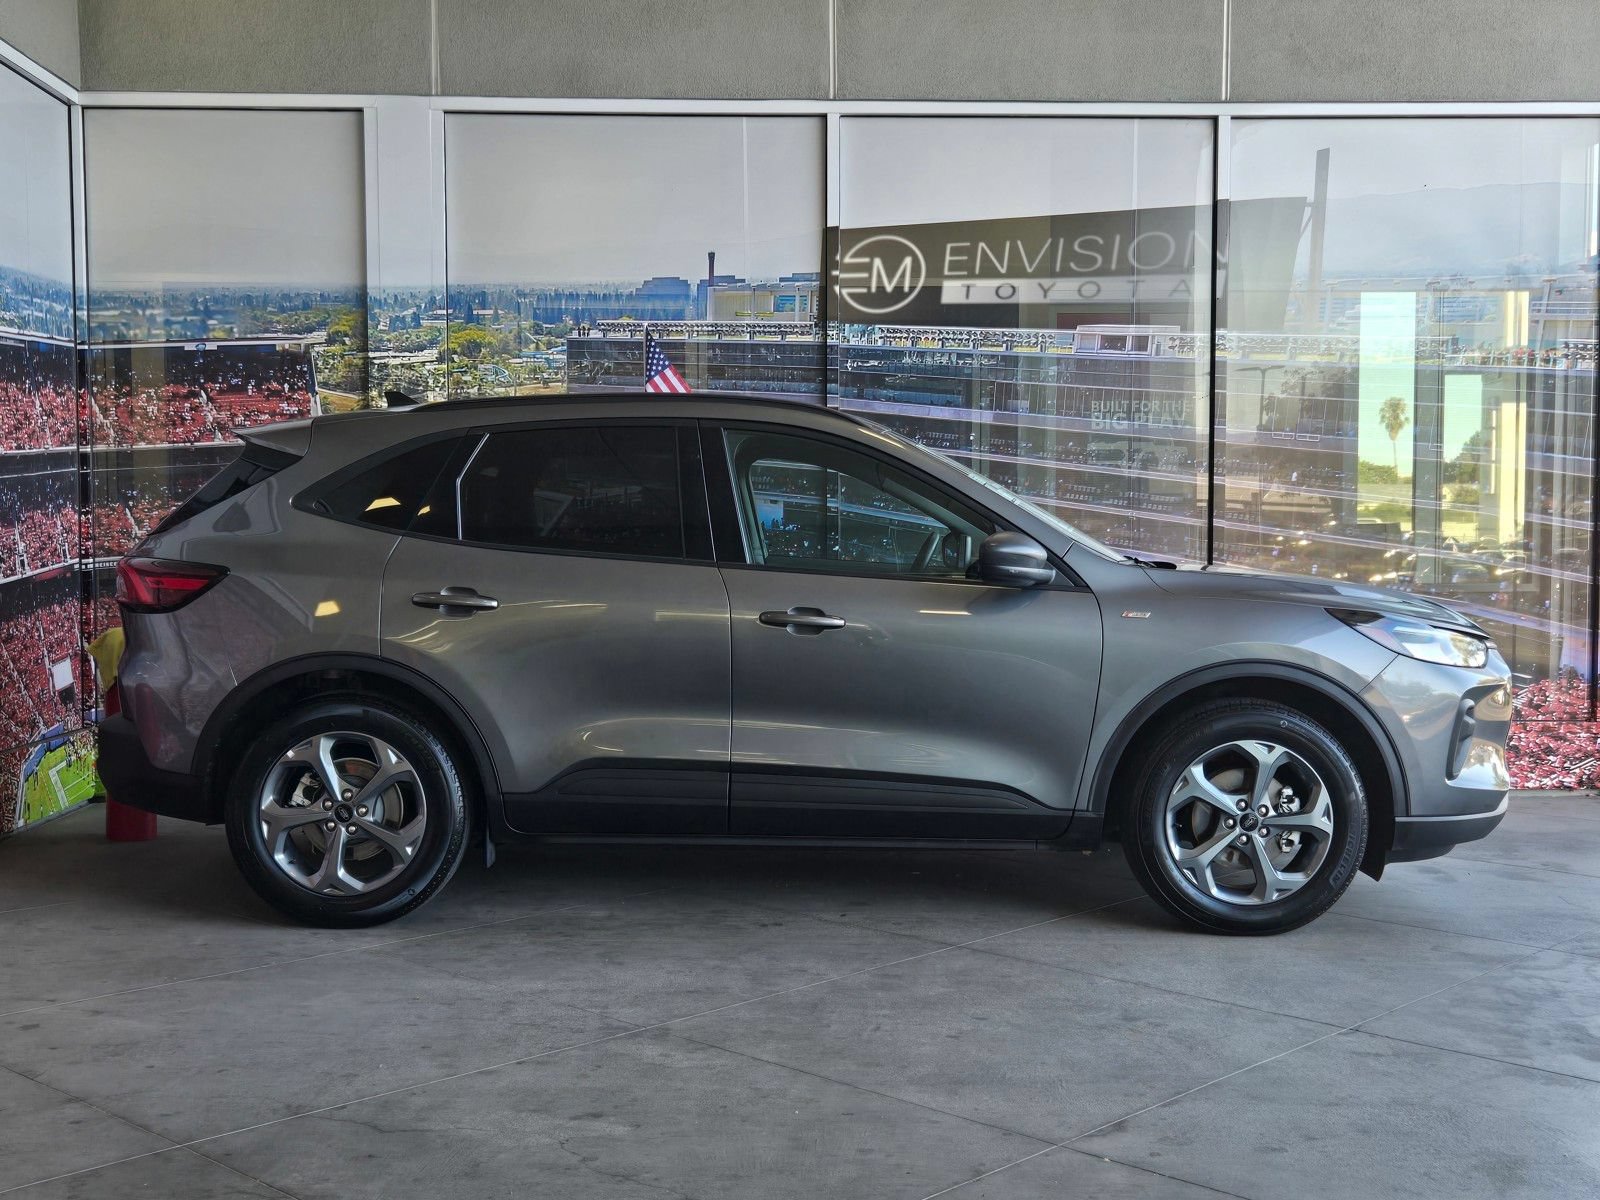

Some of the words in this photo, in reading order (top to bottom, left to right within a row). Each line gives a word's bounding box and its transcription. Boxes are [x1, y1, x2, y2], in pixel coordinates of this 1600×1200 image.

[943, 229, 1229, 276] ENVISION
[960, 279, 1192, 300] TOYOTA
[1091, 400, 1130, 412] BUILT
[1132, 400, 1161, 412] FOR
[1091, 412, 1129, 430] BIG
